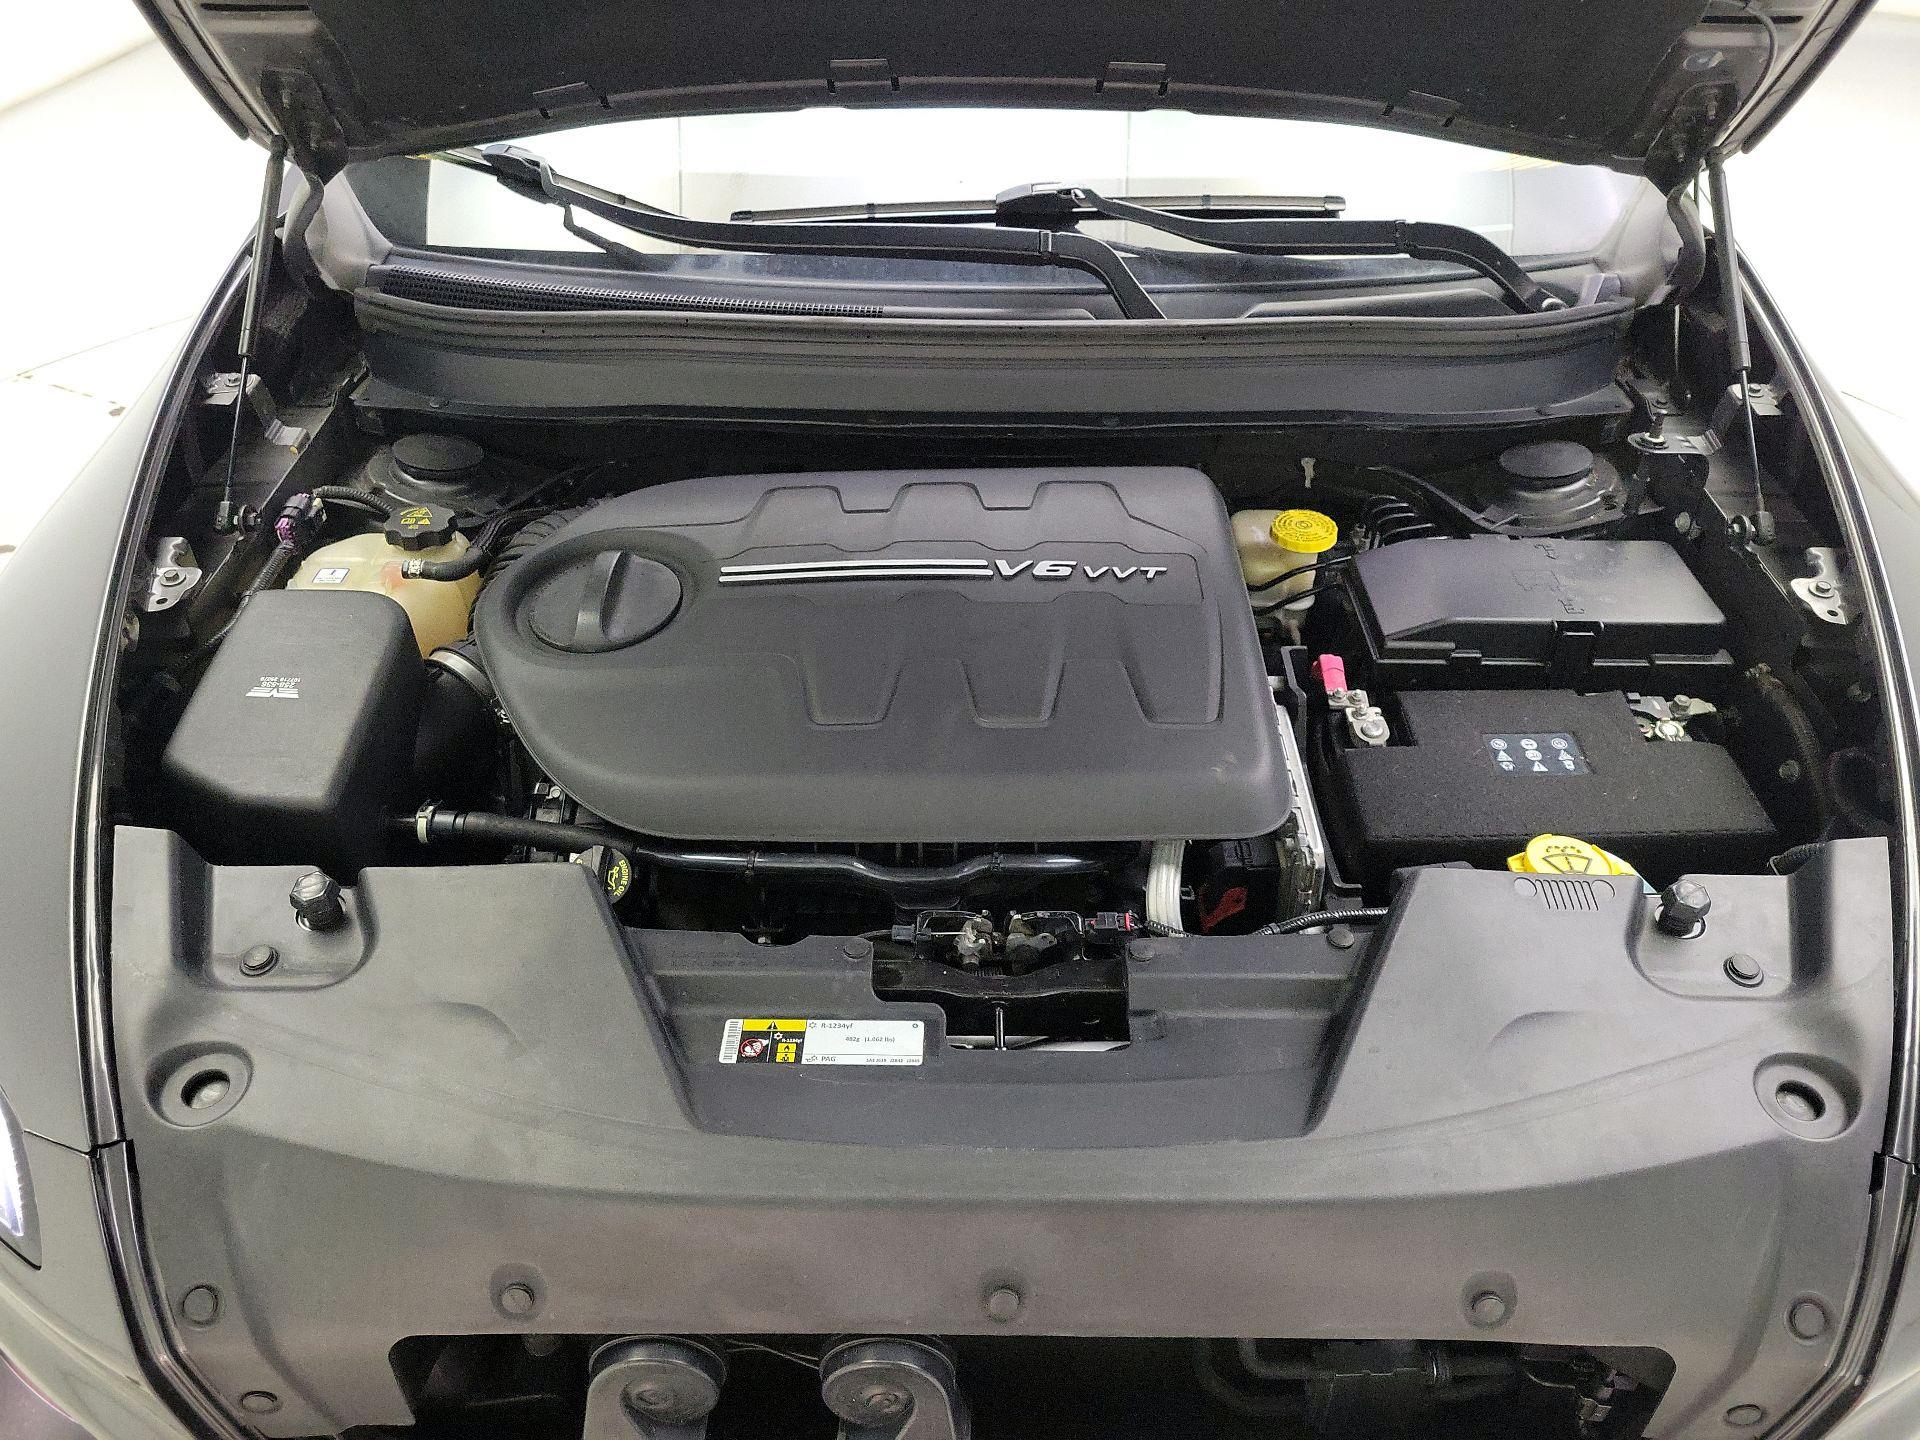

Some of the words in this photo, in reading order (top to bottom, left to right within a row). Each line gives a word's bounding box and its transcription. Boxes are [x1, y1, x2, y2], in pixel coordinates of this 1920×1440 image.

[994, 559, 1078, 578] V6
[1083, 566, 1168, 579] VVT
[618, 859, 629, 886] ENGINE
[613, 886, 625, 897] OIL
[820, 1022, 853, 1030] R-1234yf
